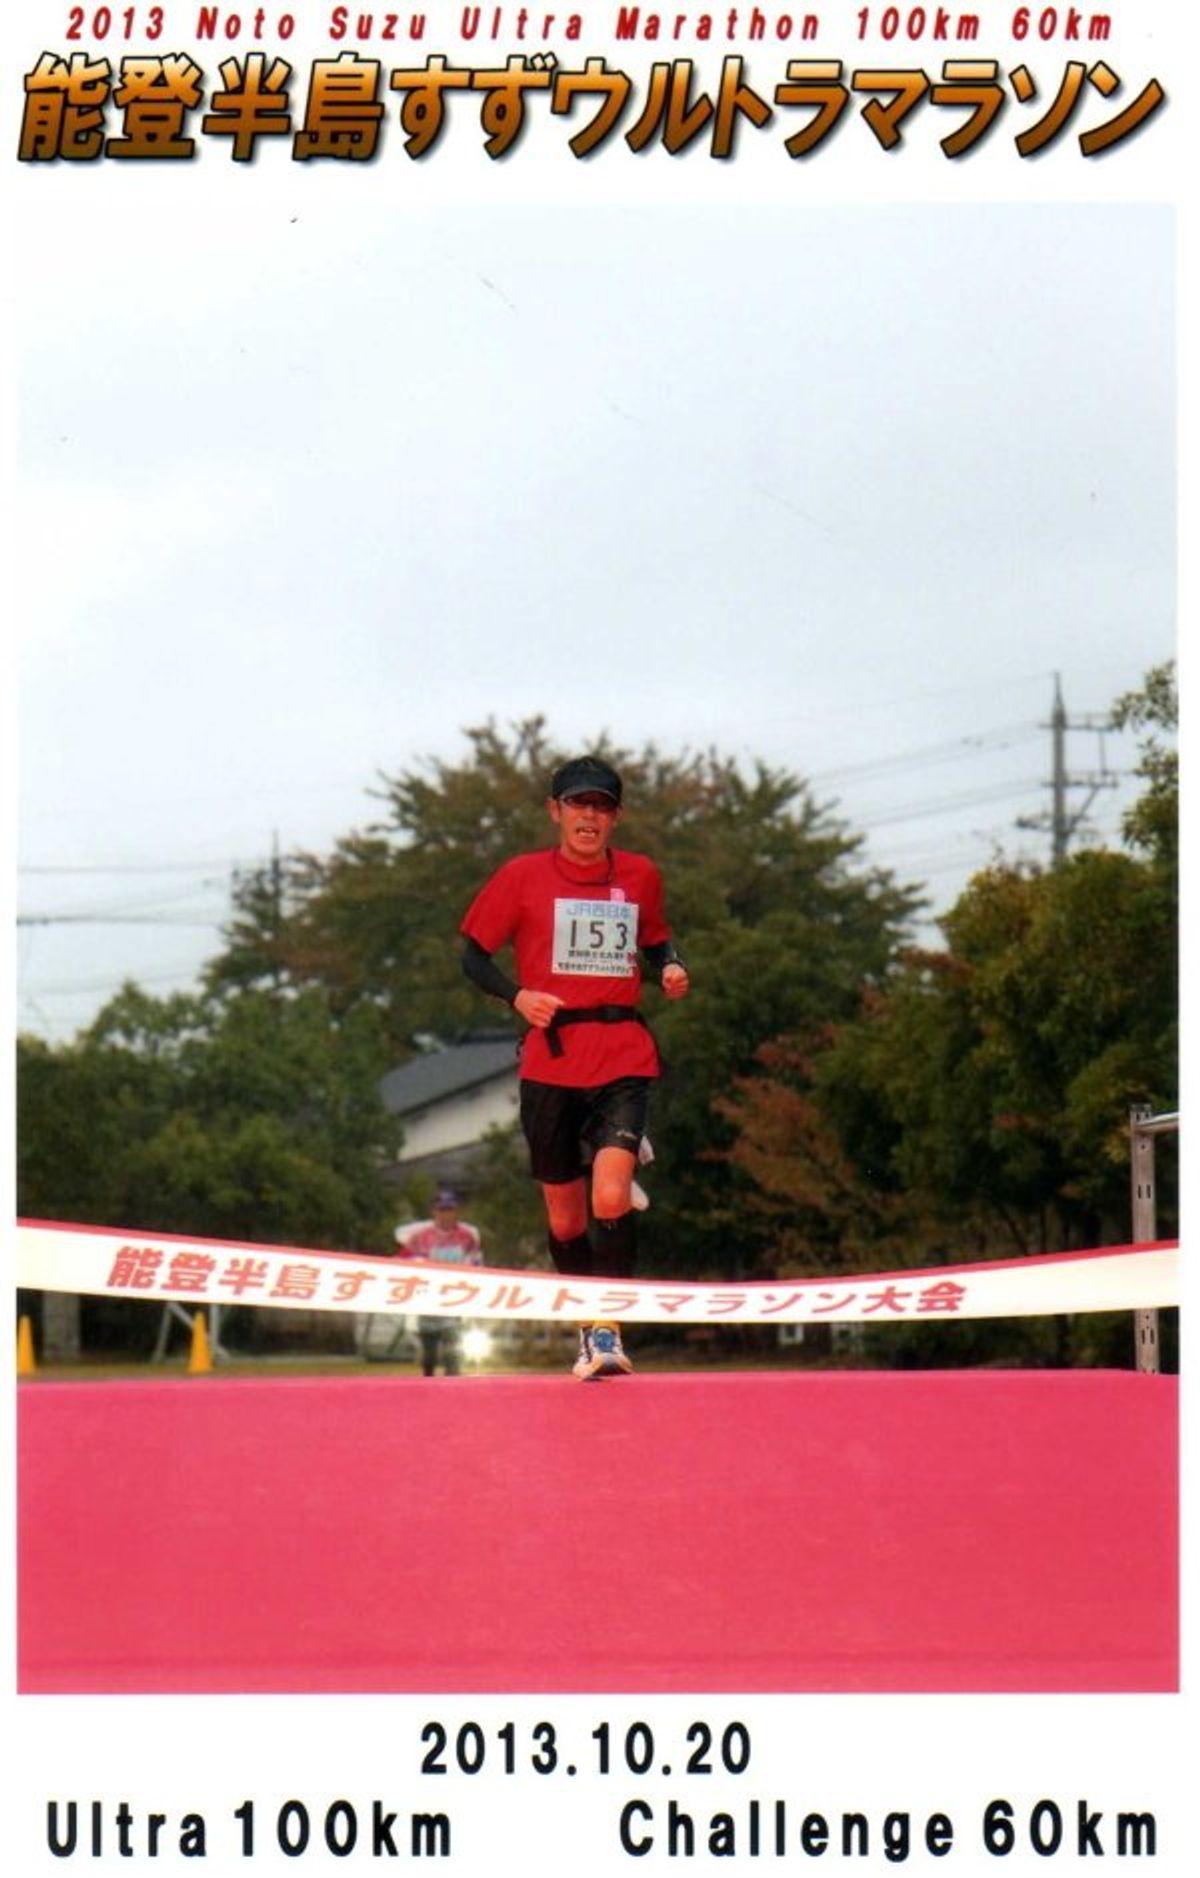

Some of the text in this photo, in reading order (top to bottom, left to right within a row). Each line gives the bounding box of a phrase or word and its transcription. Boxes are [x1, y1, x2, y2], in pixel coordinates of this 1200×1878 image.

[570, 920, 628, 950] 153
[107, 1246, 967, 1317] 能登半島すずウルトラマラソン大会
